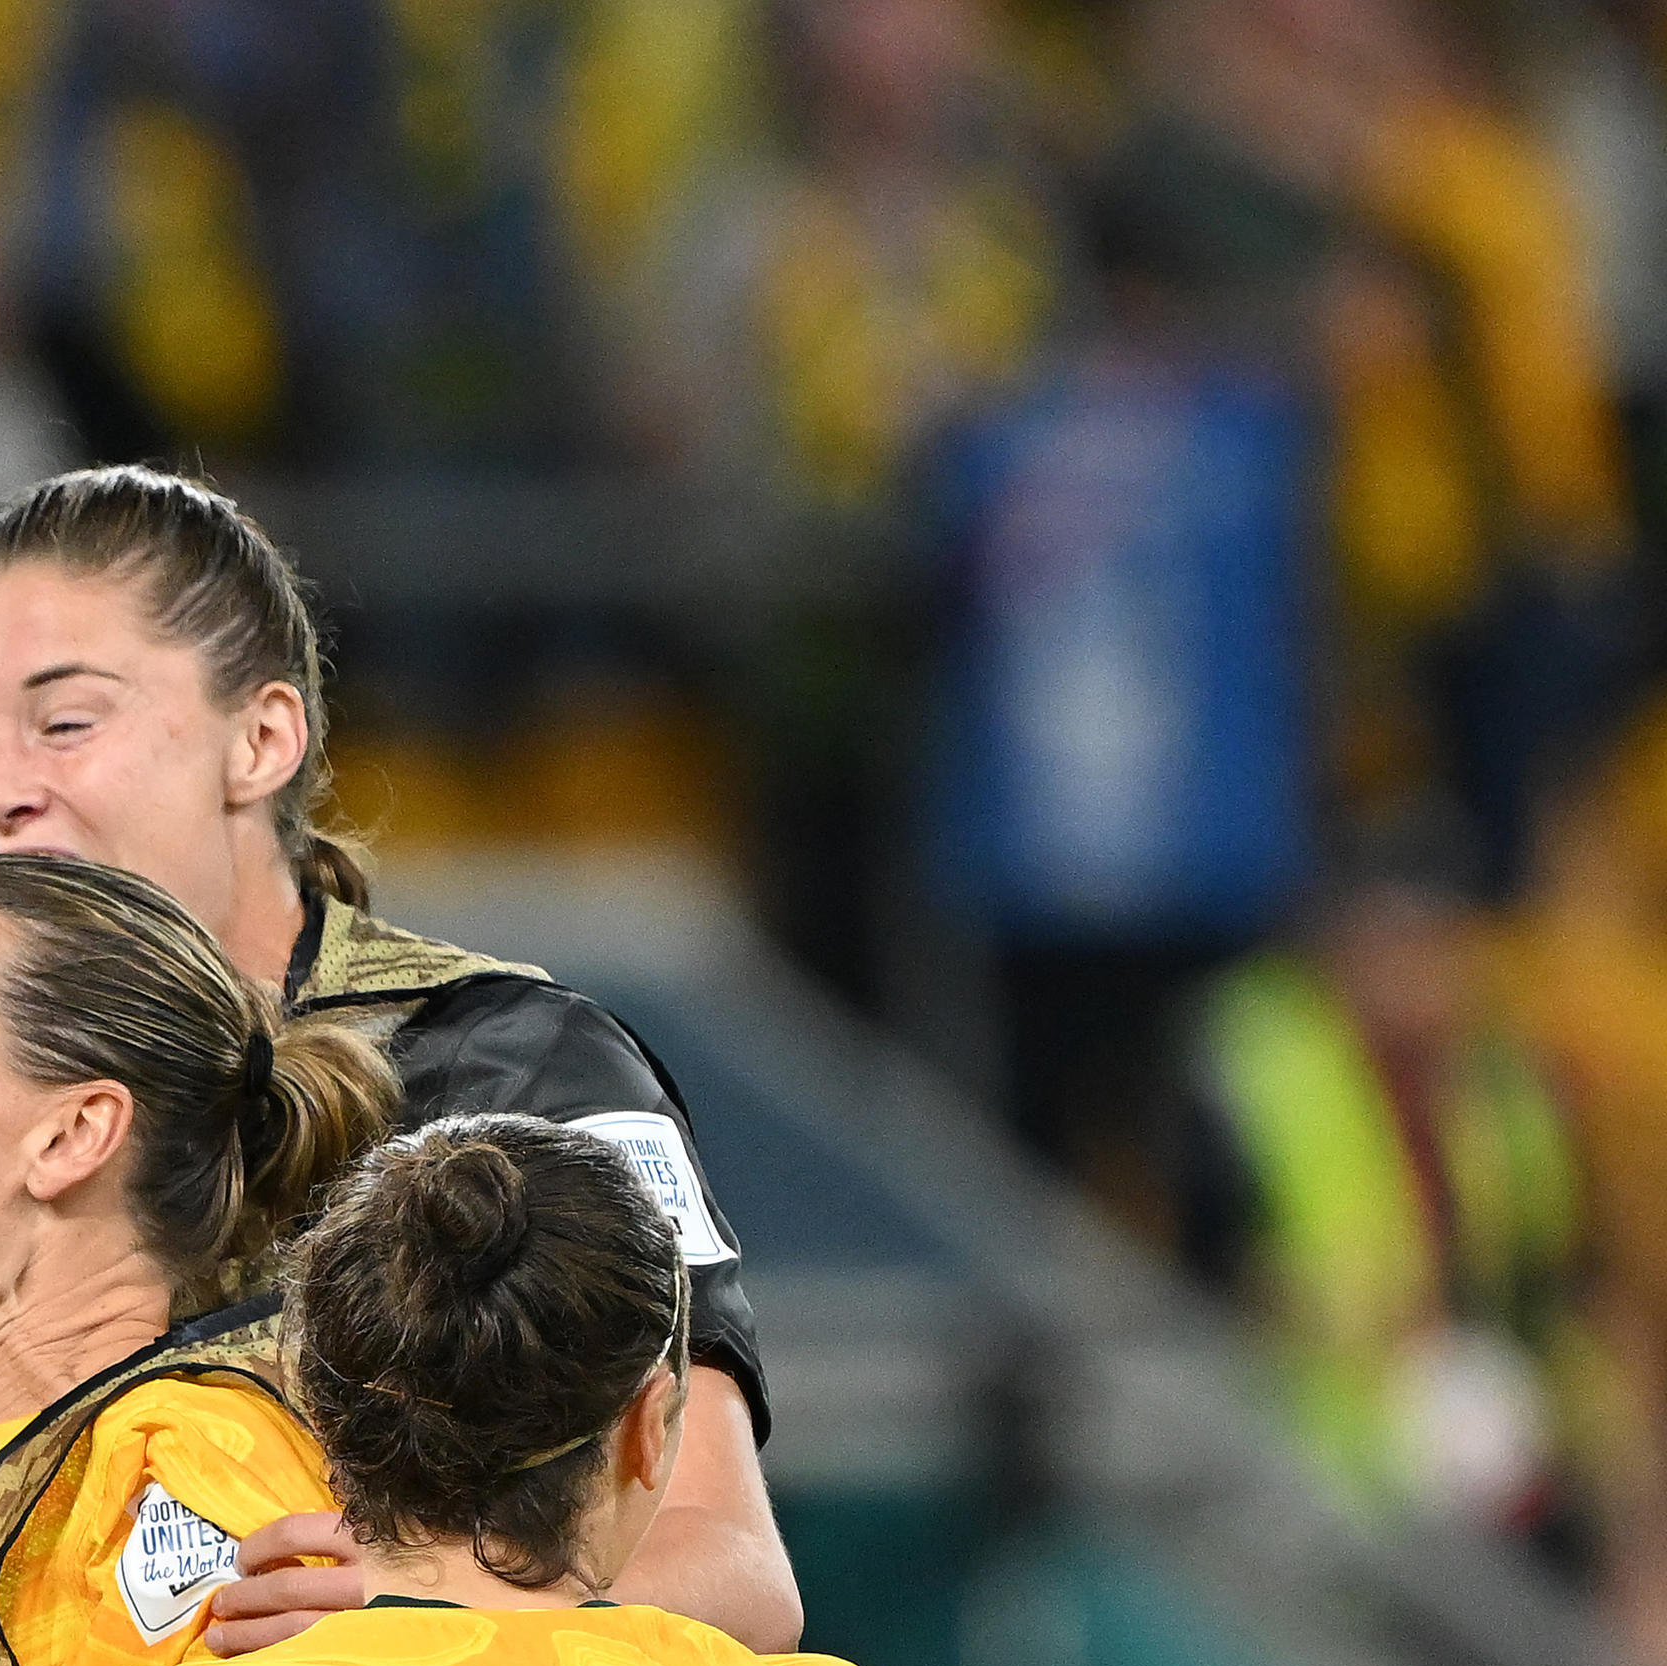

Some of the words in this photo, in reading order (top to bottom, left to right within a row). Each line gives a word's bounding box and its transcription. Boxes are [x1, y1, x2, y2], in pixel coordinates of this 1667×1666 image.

[618, 1139, 669, 1158] OTBALL
[635, 1159, 678, 1186] ITES
[140, 1500, 198, 1525] FOOTB
[142, 1520, 228, 1555] UNITES
[139, 1558, 174, 1582] the
[177, 1545, 236, 1577] World
